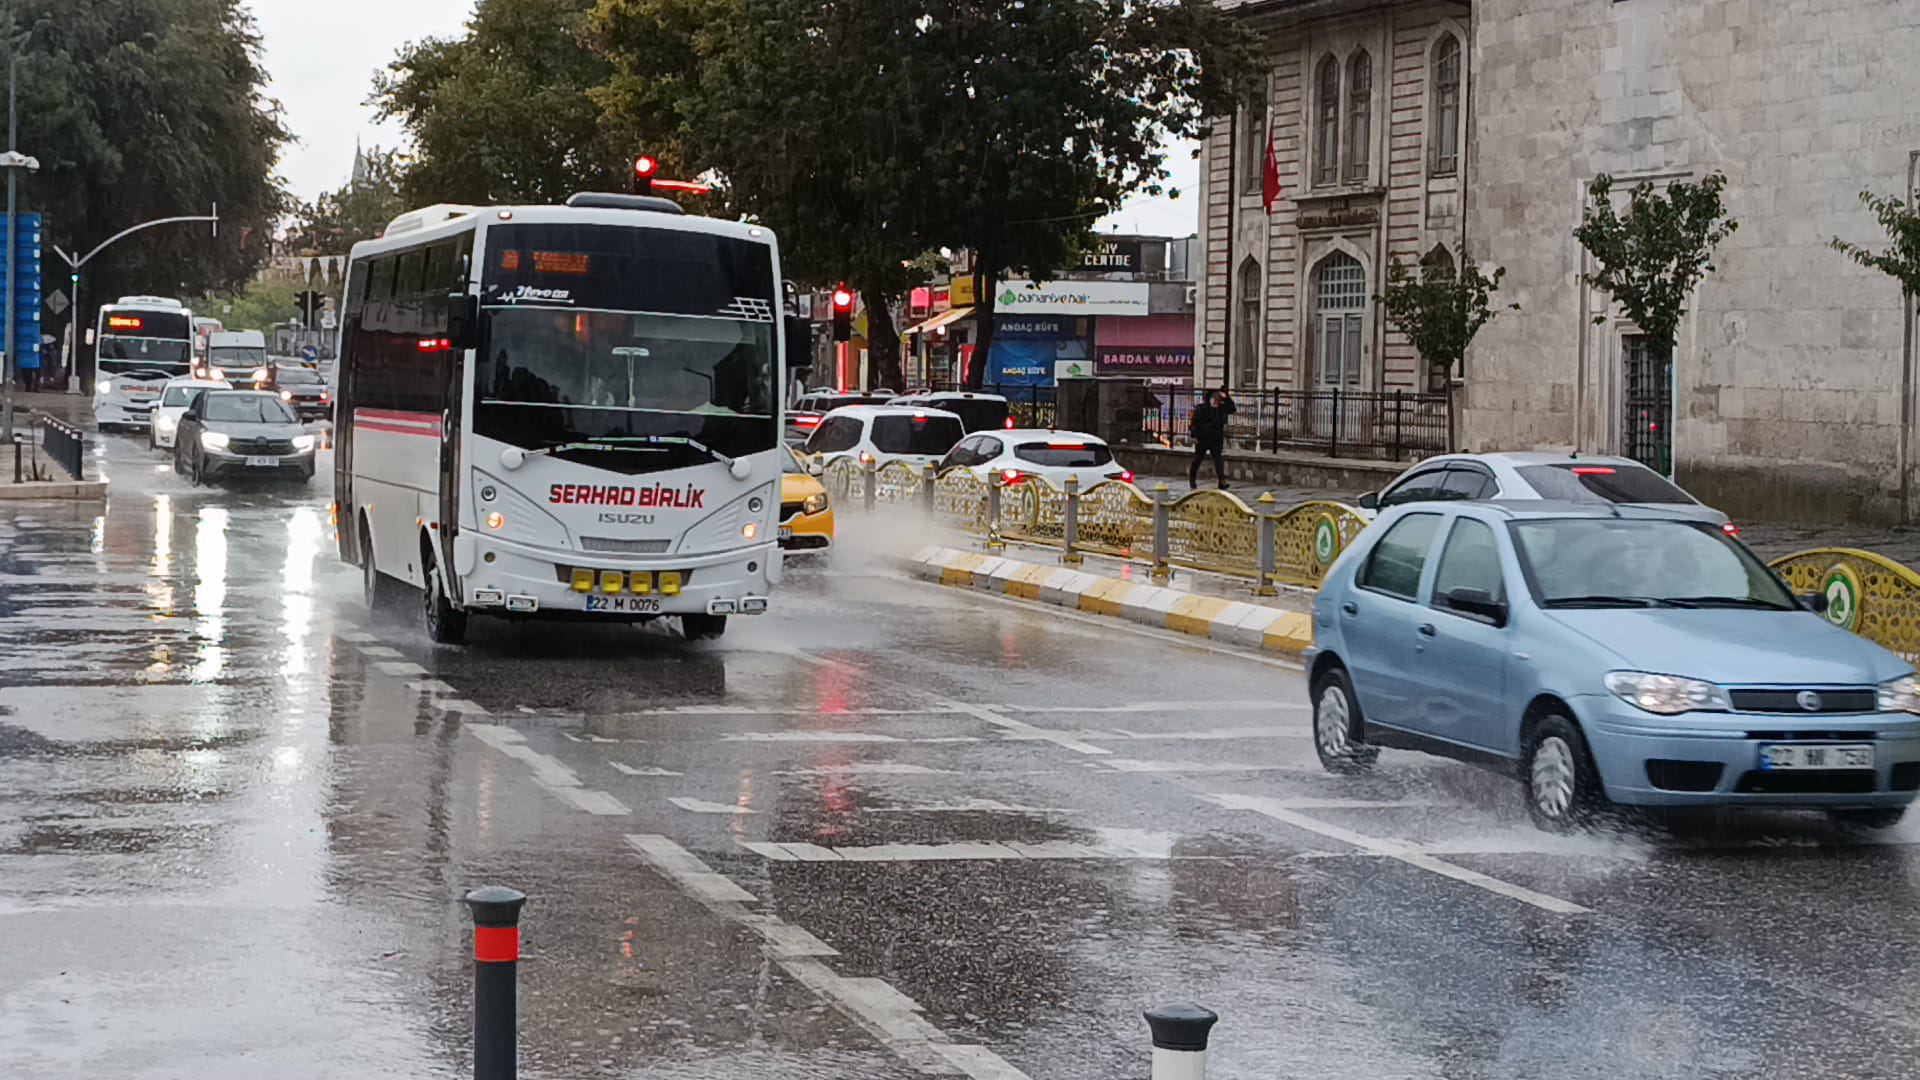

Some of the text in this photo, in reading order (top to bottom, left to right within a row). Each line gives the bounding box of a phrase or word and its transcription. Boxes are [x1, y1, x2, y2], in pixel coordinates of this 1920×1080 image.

[1103, 354, 1193, 365] BARDAK WAFFL
[549, 481, 706, 508] SERHAD BİRLİK
[598, 513, 655, 525] ISUZU
[593, 597, 608, 610] 22
[629, 598, 660, 611] 0076
